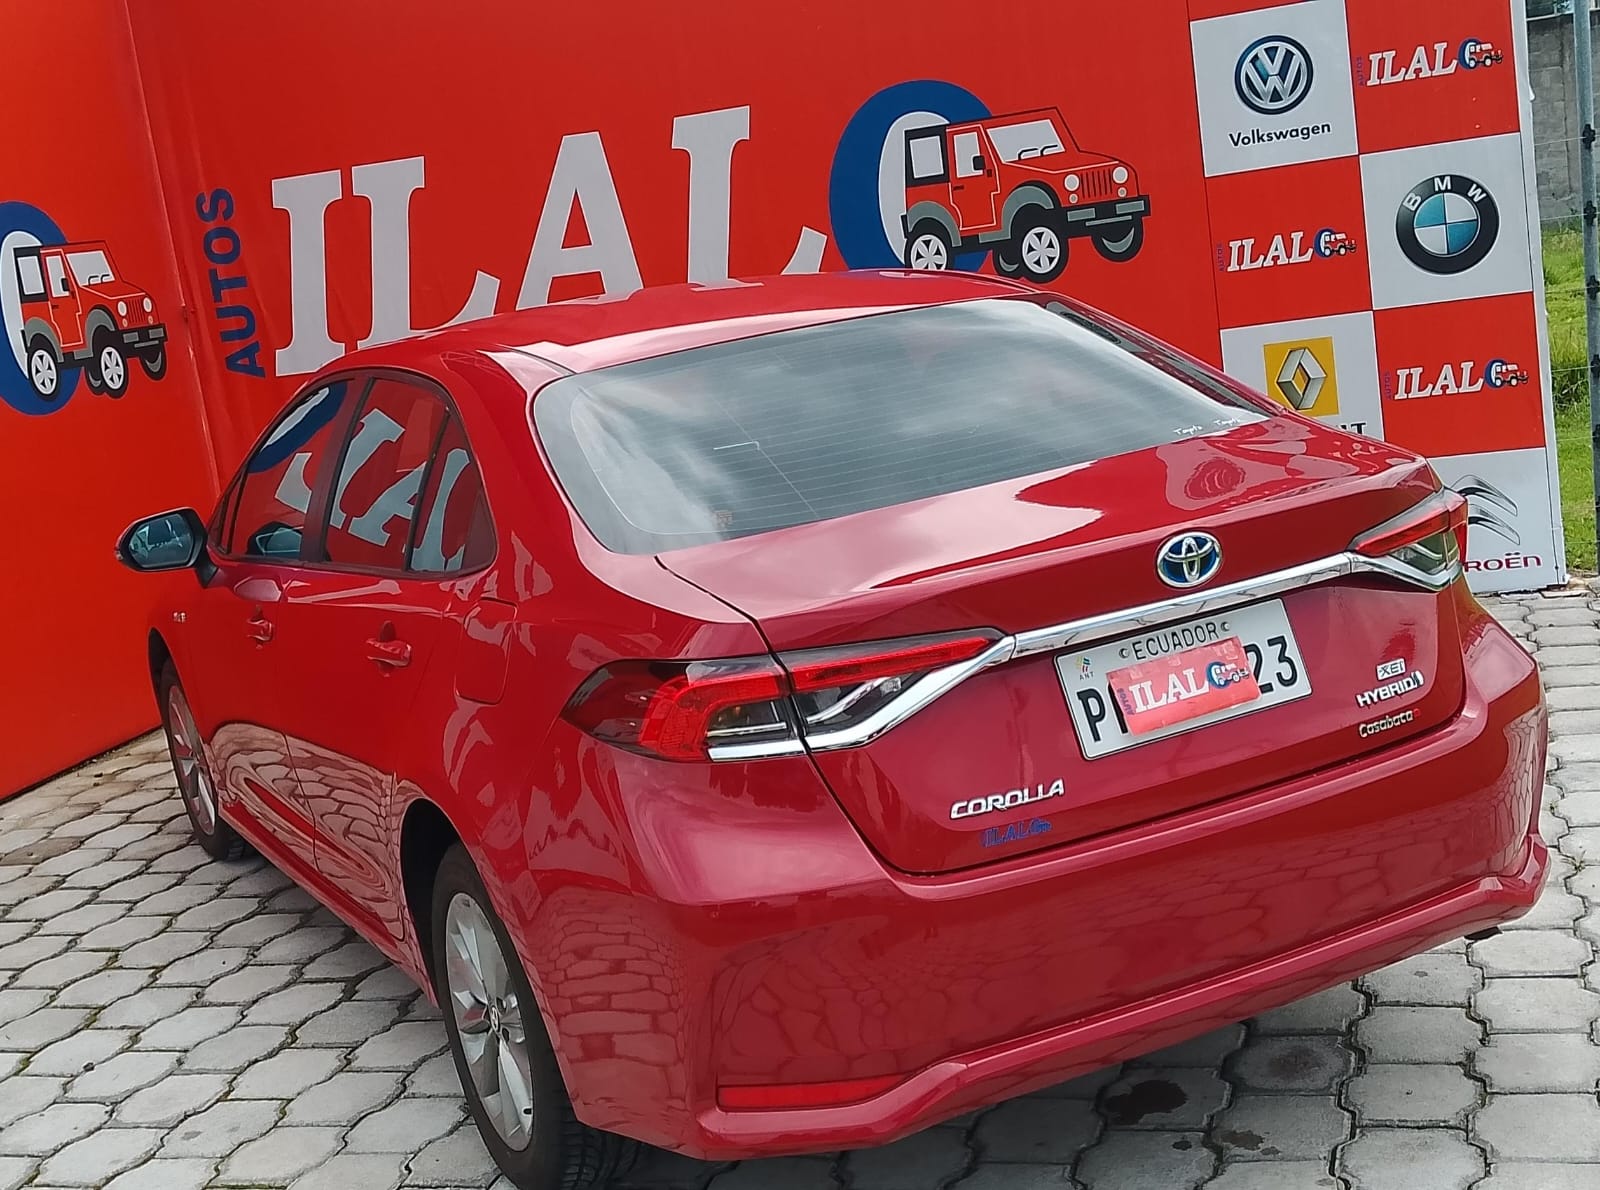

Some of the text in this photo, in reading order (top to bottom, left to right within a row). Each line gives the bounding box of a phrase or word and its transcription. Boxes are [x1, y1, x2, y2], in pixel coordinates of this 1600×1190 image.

[1229, 122, 1331, 147] Volkswagen
[1402, 175, 1487, 211] BMW
[194, 188, 267, 379] AUTOS
[1131, 621, 1220, 660] ECUADOR
[1116, 687, 1135, 716] AUTOS
[1356, 671, 1422, 707] HYBRID
[950, 778, 1065, 819] COROLLA
